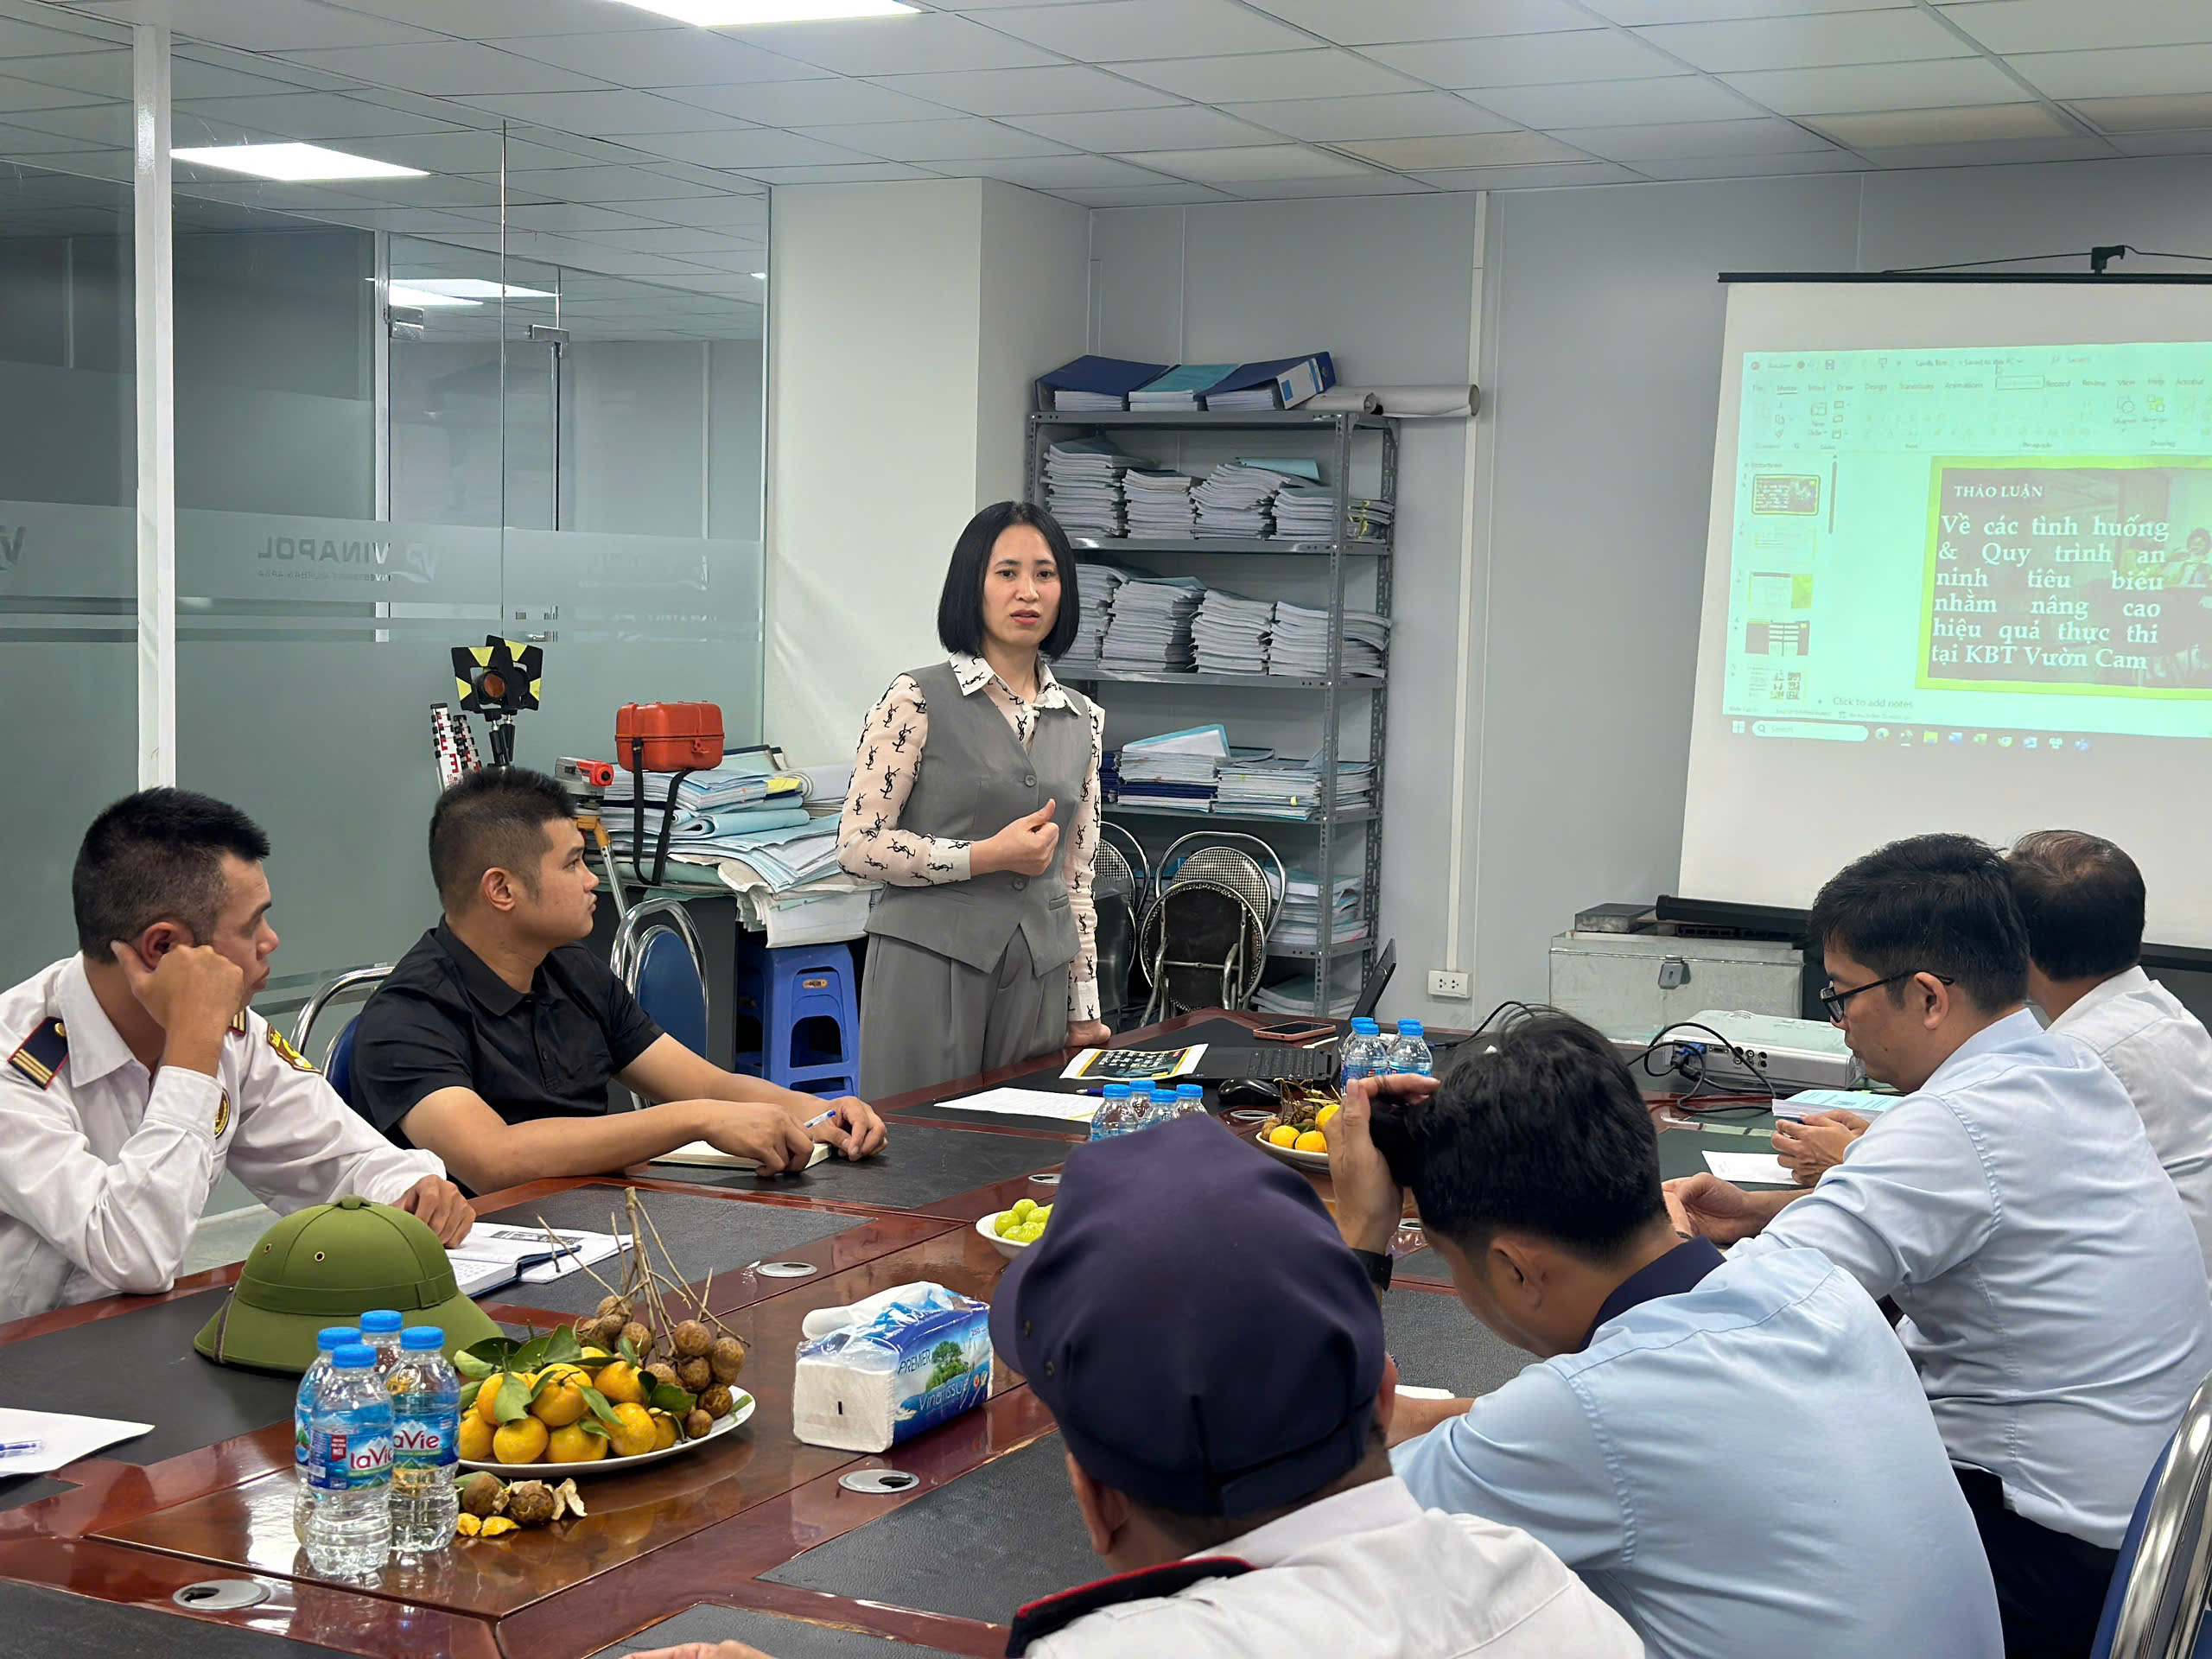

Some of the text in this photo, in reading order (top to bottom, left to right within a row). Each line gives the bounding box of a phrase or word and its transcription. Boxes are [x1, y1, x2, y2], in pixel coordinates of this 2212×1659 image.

[1955, 483, 2044, 499] THẢO LUẬN
[1941, 512, 2171, 542] Về các tình huống
[1938, 541, 2166, 567] & Quy trình an
[1936, 567, 1989, 588] ninh
[2027, 569, 2072, 588] tiêu
[1934, 589, 2162, 620] nhằm nâng cao
[1932, 618, 2159, 645] hiệu quả thực thi
[1931, 645, 1959, 665] tại
[1964, 645, 2018, 664] KBT
[2094, 649, 2149, 671] Cam
[1832, 696, 1914, 709] Click to add notes
[393, 1429, 439, 1450] aVie
